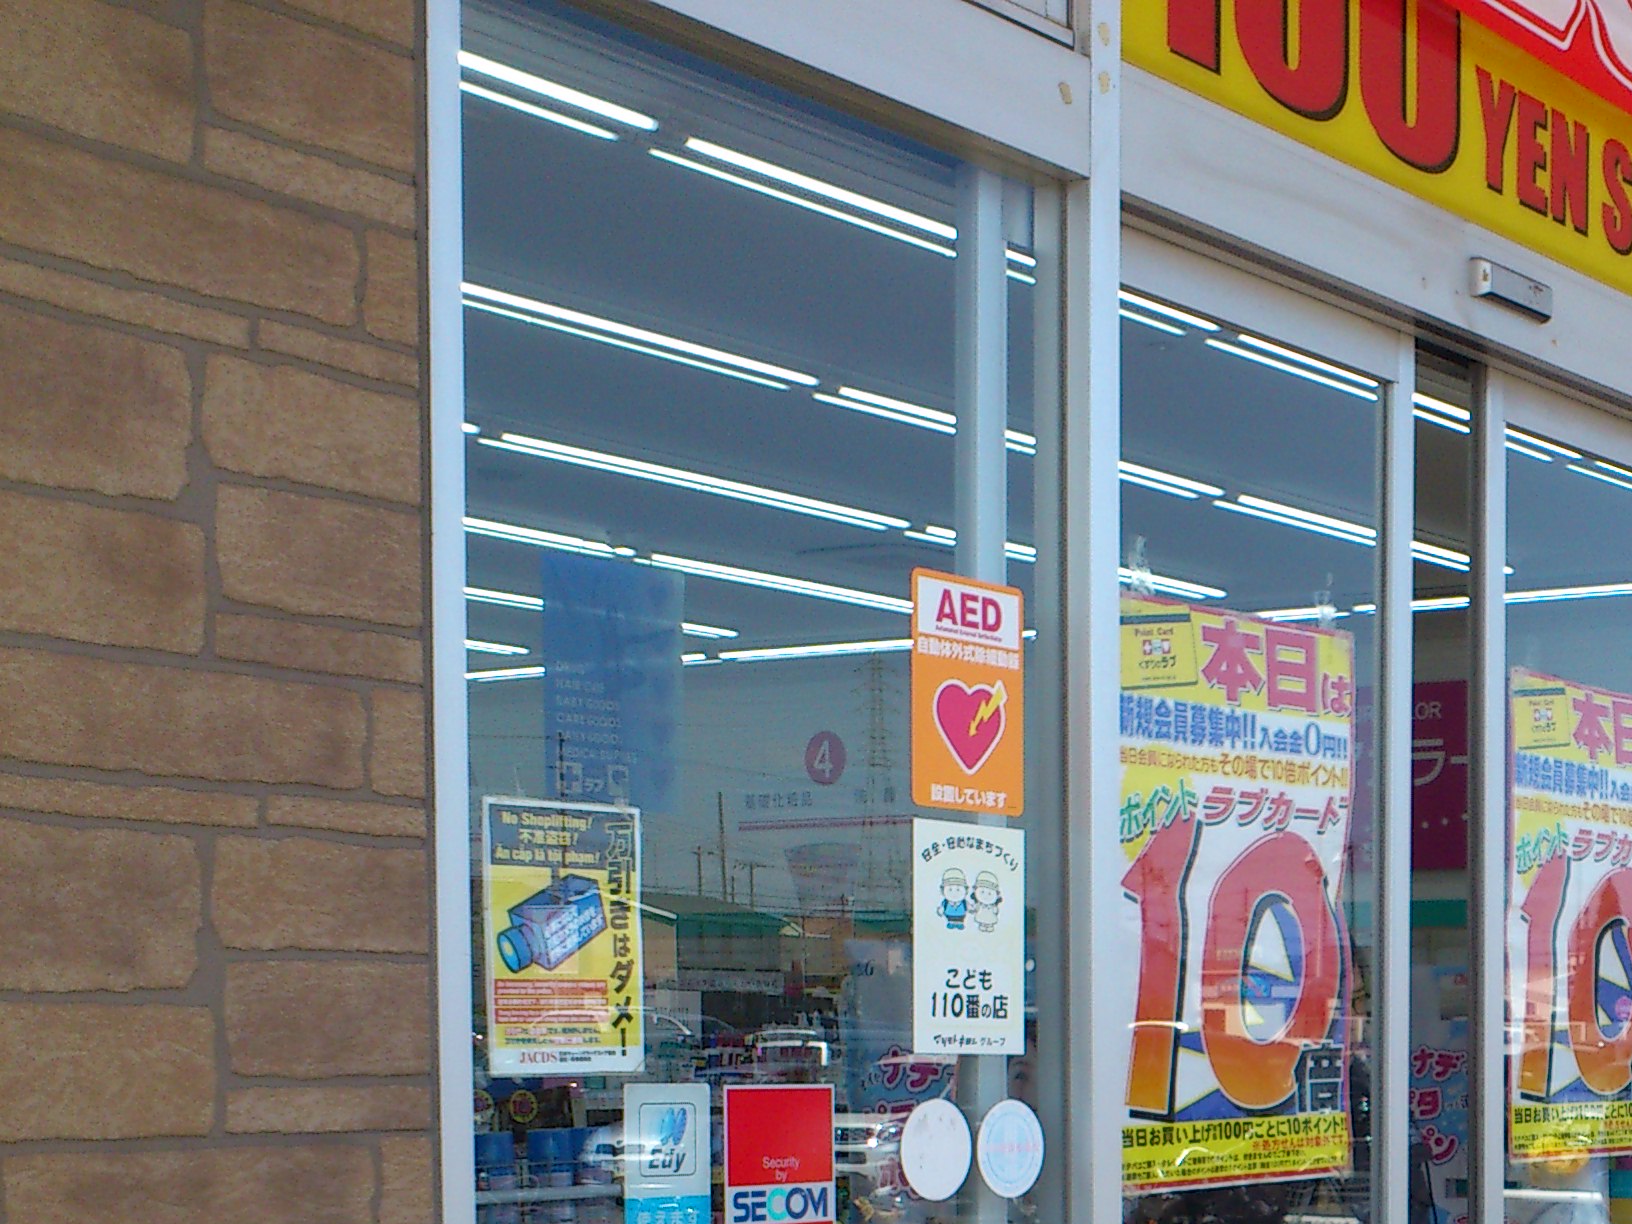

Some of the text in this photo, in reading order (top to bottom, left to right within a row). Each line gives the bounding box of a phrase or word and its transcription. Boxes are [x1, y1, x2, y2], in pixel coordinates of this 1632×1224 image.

[1475, 64, 1590, 237] YEN
[936, 588, 1002, 632] AED
[1201, 615, 1352, 717] 本日は
[1411, 702, 1442, 720] OR
[813, 740, 834, 778] 4
[945, 969, 993, 990] こども
[931, 992, 1009, 1019] 110番の店
[519, 1051, 558, 1064] JACDS
[649, 1148, 686, 1173] Edy
[762, 1156, 800, 1170] Security
[775, 1169, 788, 1182] by
[733, 1187, 828, 1223] SECOM
